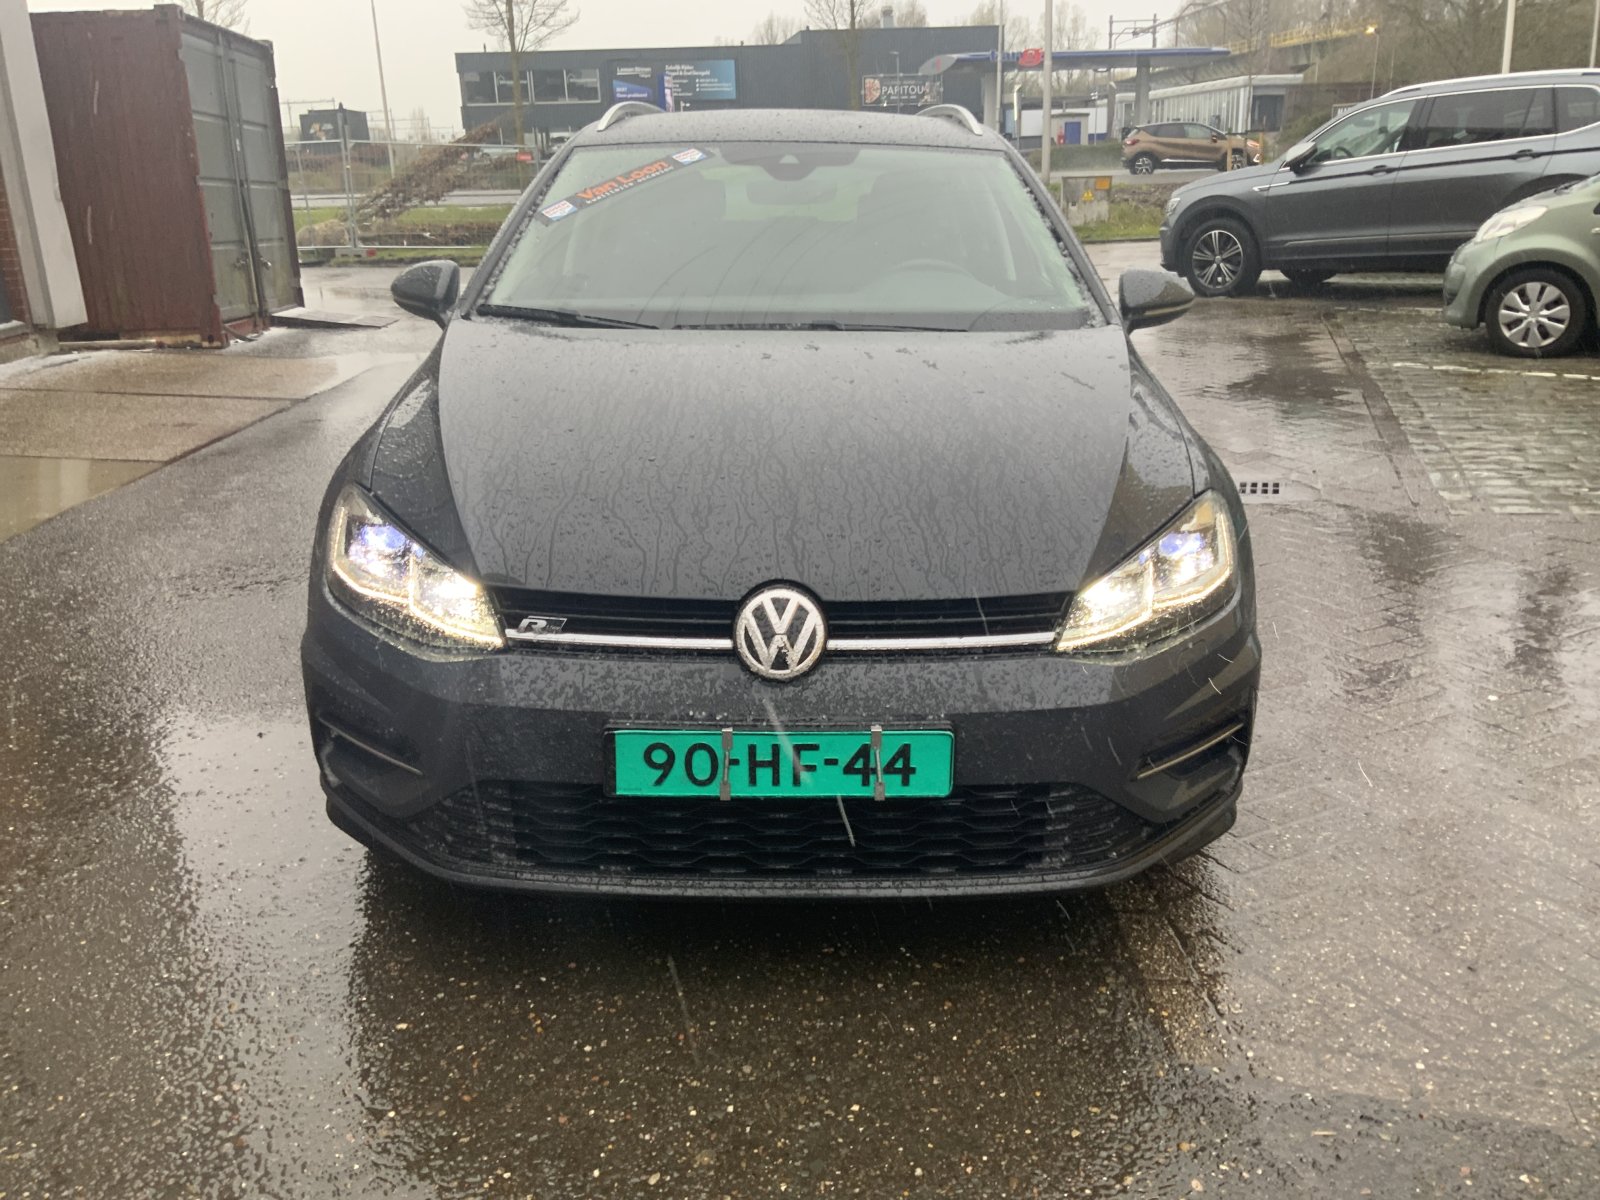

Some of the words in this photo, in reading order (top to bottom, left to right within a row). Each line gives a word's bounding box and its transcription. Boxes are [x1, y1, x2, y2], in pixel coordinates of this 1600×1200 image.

[576, 180, 618, 199] Van
[616, 160, 669, 184] Loon
[643, 742, 917, 787] 90-HF-44
